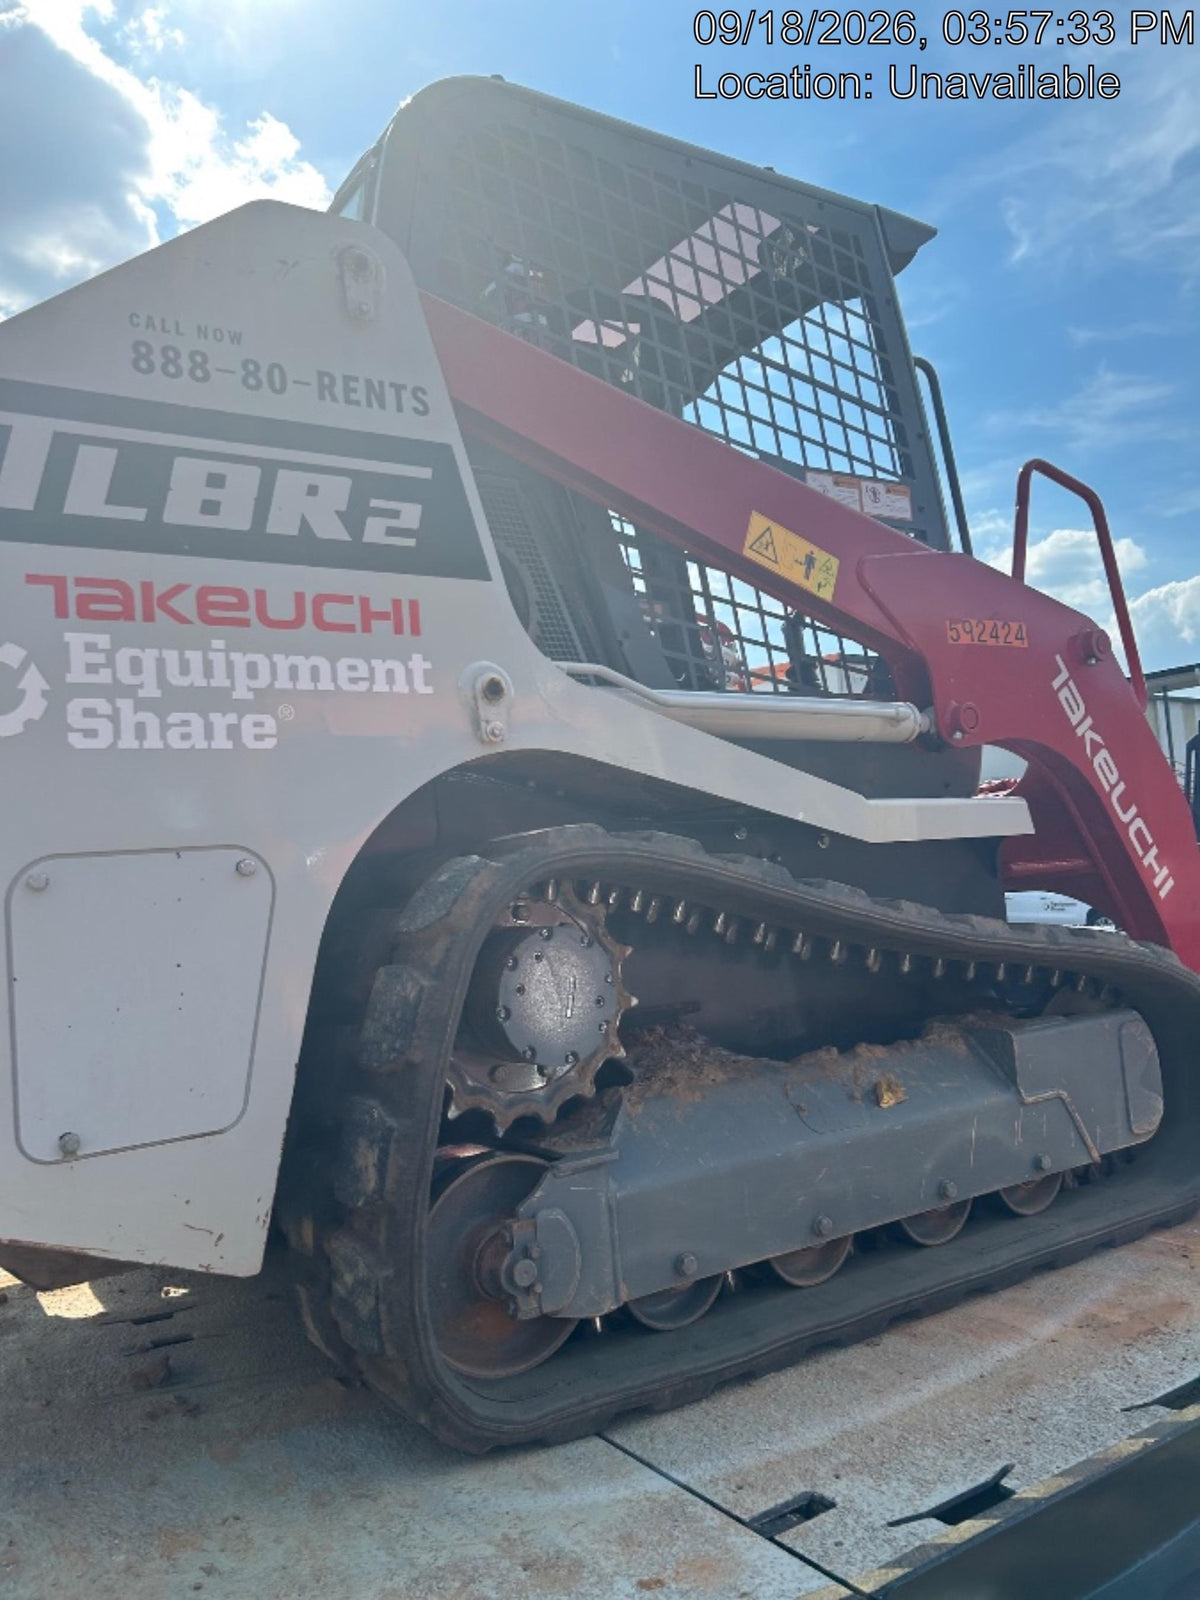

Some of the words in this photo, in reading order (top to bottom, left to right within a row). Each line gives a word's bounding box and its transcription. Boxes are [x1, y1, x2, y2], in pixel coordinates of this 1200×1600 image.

[128, 311, 186, 337] CALL
[196, 324, 244, 347] NOW
[131, 339, 431, 417] 888-80-RENTS
[948, 619, 1026, 646] 592424
[64, 632, 434, 700] Equipment
[65, 697, 279, 750] Share
